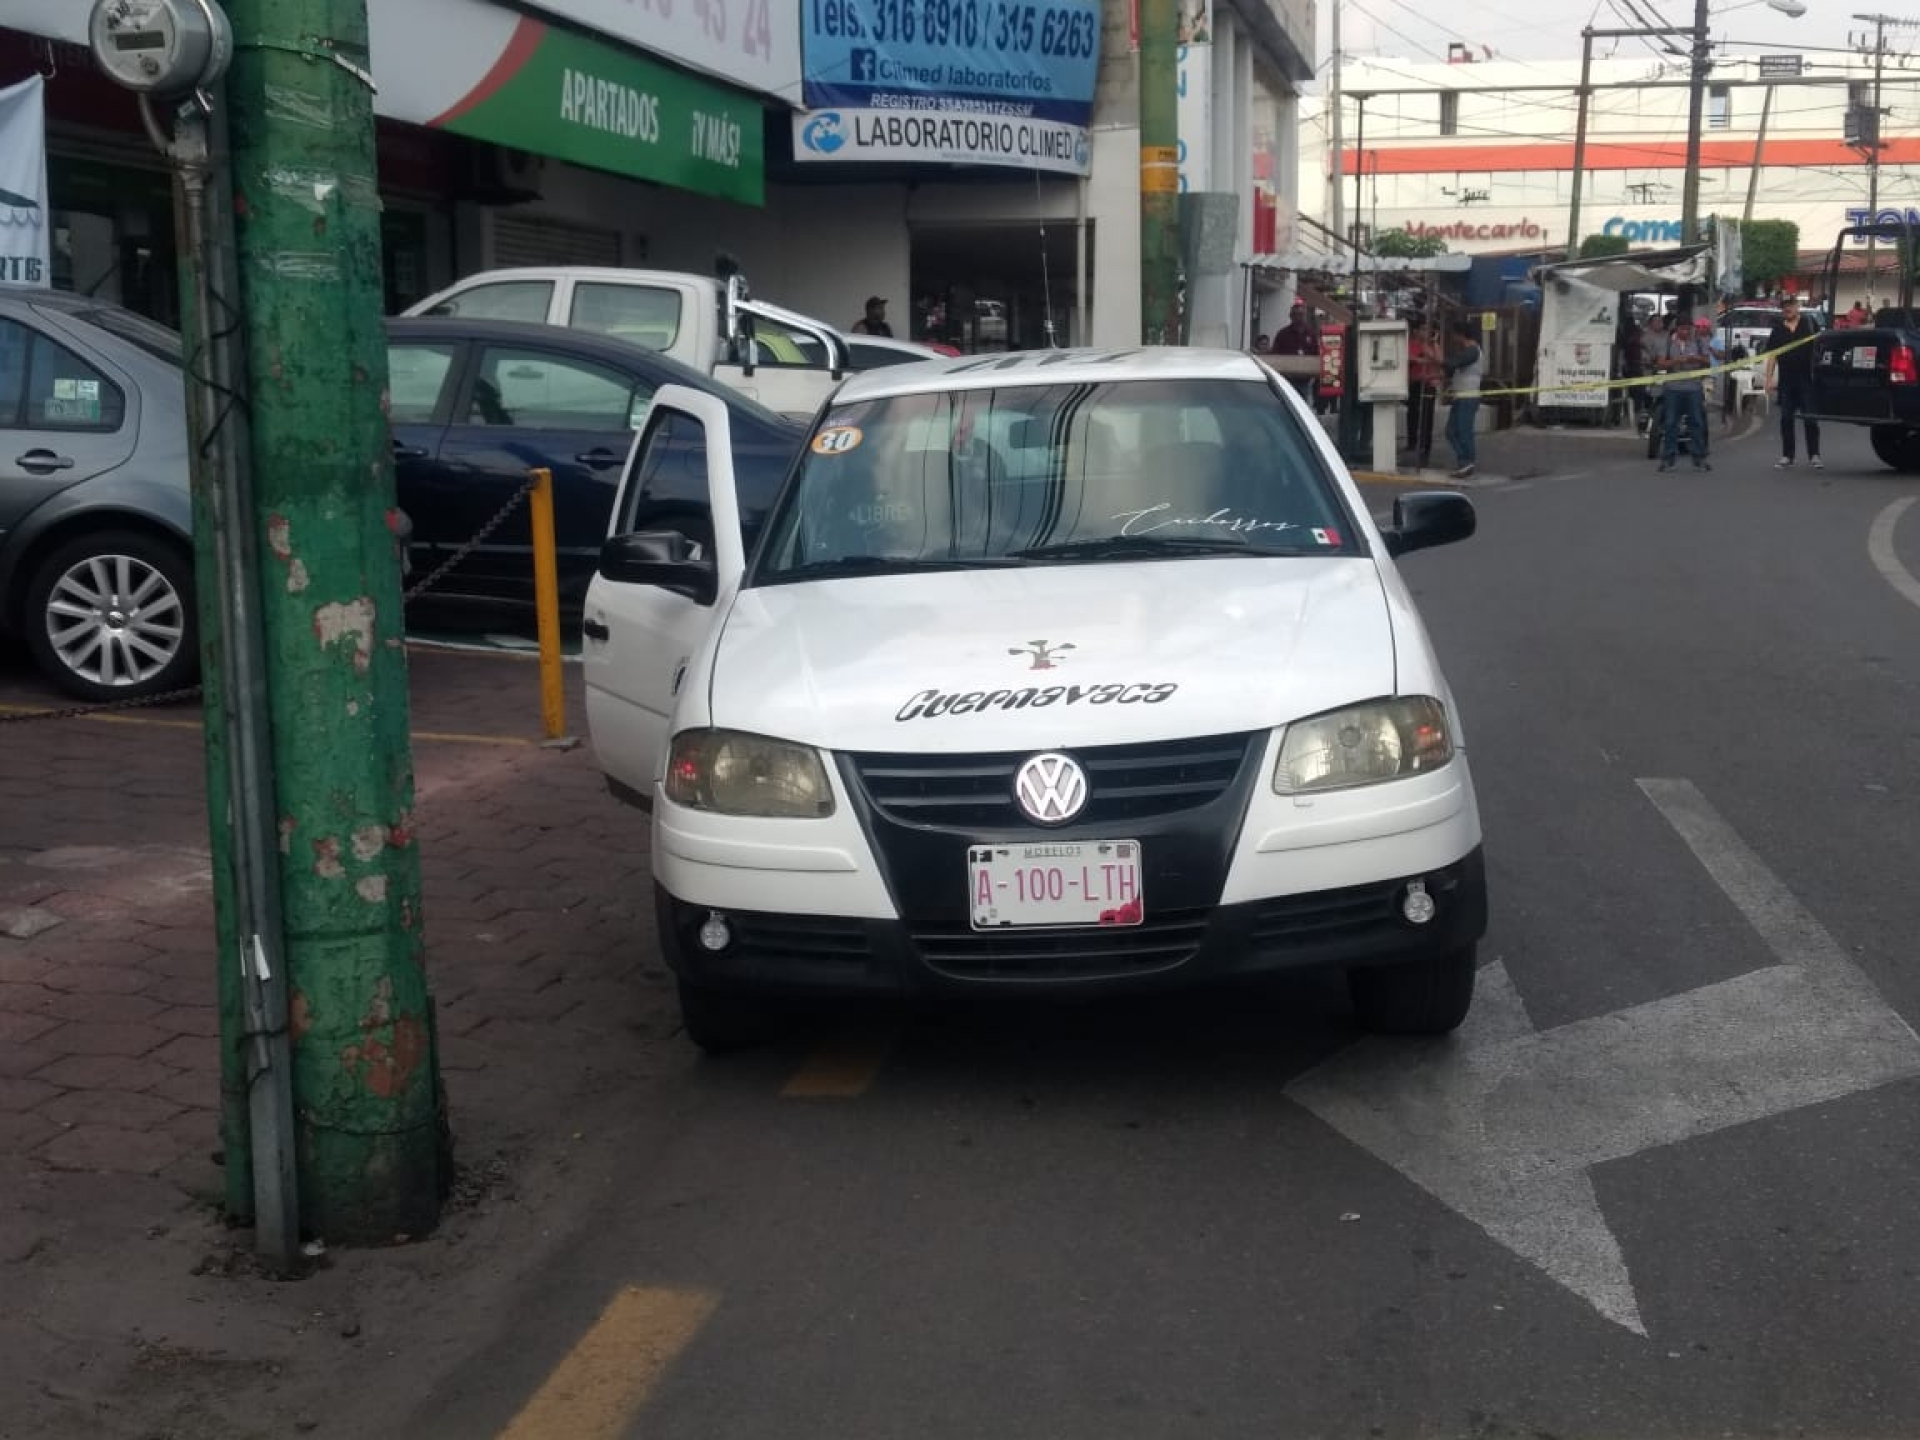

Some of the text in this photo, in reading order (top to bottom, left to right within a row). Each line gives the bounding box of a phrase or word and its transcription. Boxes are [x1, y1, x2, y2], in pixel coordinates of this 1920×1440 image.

[872, 0, 915, 43] 316
[924, 0, 977, 48] 6910
[995, 3, 1036, 53] 315
[1041, 8, 1094, 58] 6263
[879, 58, 1052, 92] Climed laboratorios
[560, 68, 660, 144] APARTADOS
[855, 116, 1072, 160] LABORATORIO CLIMED
[1405, 217, 1540, 240] Montecarlo
[1603, 216, 1684, 241] Come
[822, 429, 852, 451] 30
[895, 682, 1178, 722] Cuernavaca
[1025, 846, 1081, 858] MORELOS
[977, 864, 1136, 906] A-100-LTH
